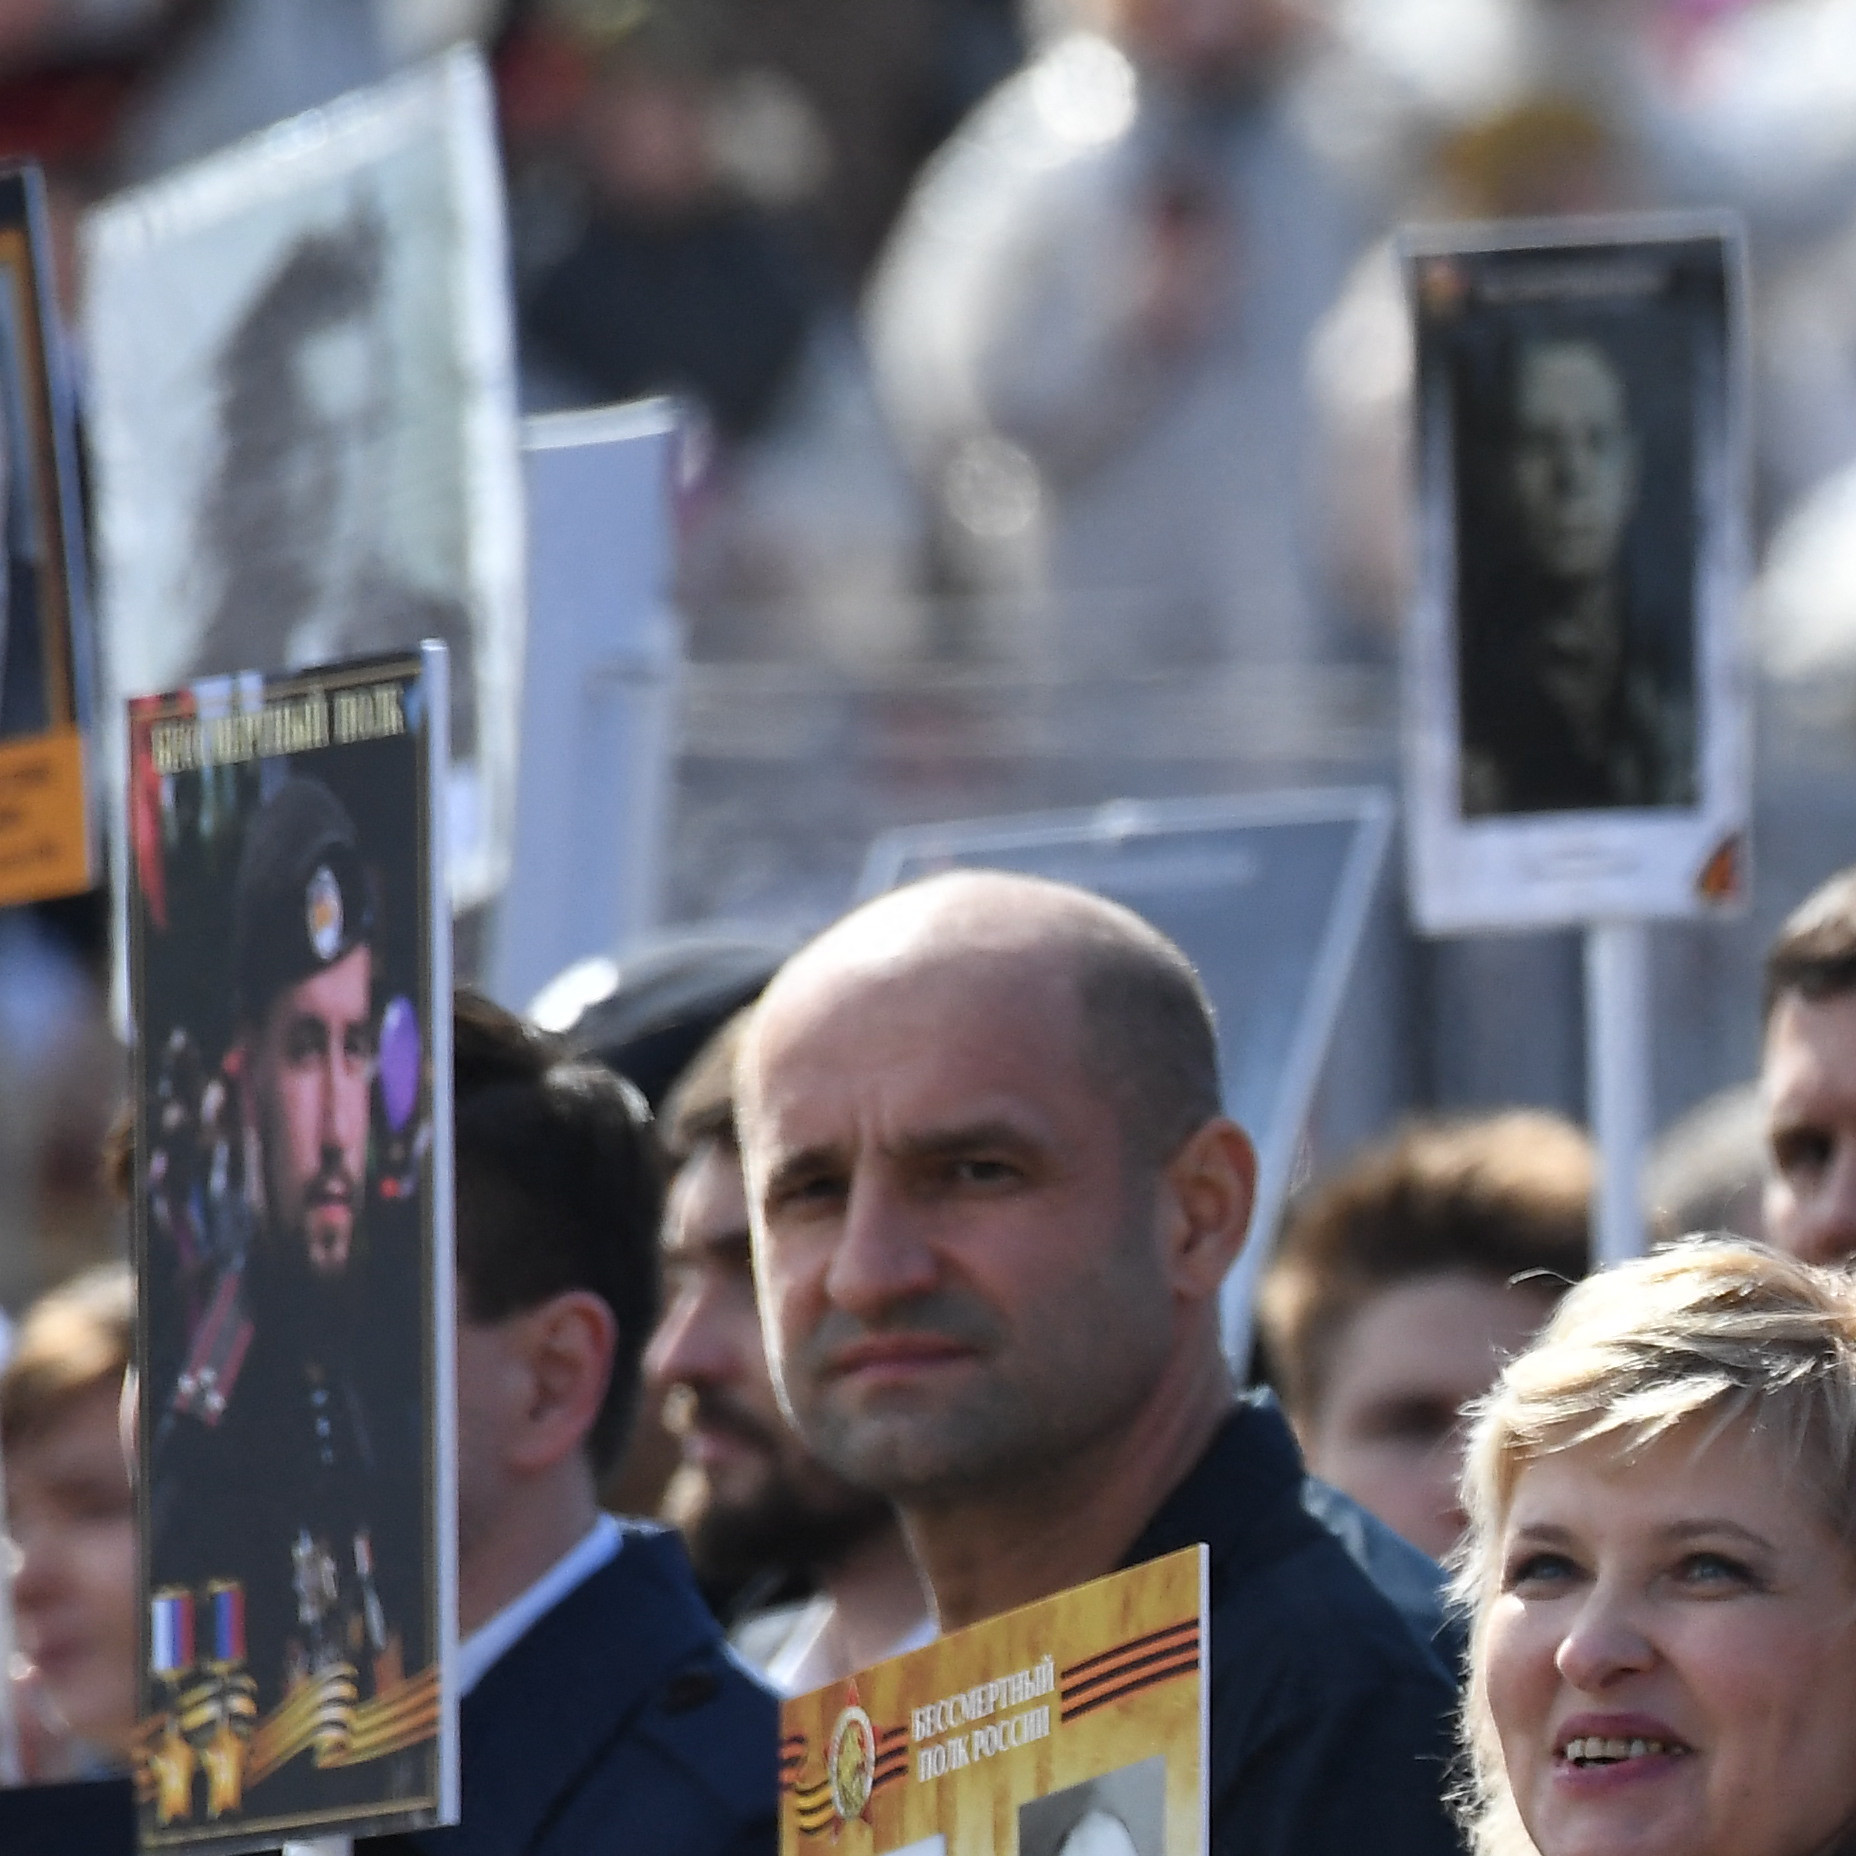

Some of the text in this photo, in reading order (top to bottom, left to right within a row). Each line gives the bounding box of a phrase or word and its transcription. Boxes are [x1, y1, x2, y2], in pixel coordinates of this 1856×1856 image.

[911, 1653, 1056, 1742] БЕССМЕРТНЫЙ
[918, 1734, 970, 1783] ПОЛК
[972, 1705, 1050, 1762] РОССИИ
